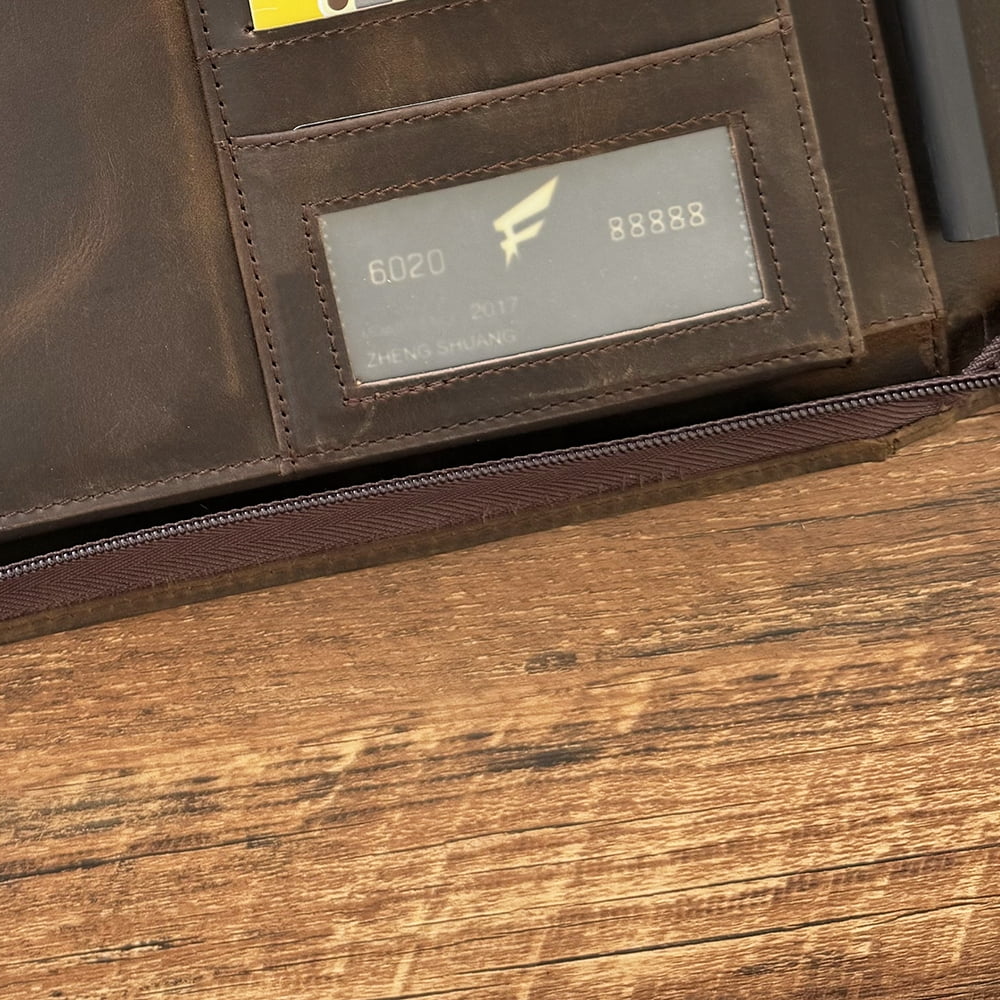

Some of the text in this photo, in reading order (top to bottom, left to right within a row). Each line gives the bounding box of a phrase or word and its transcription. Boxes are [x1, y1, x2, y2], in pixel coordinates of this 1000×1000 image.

[368, 202, 706, 286] 6020 88888
[469, 296, 519, 320] 2017
[367, 327, 518, 368] ZHENG SHUANG
